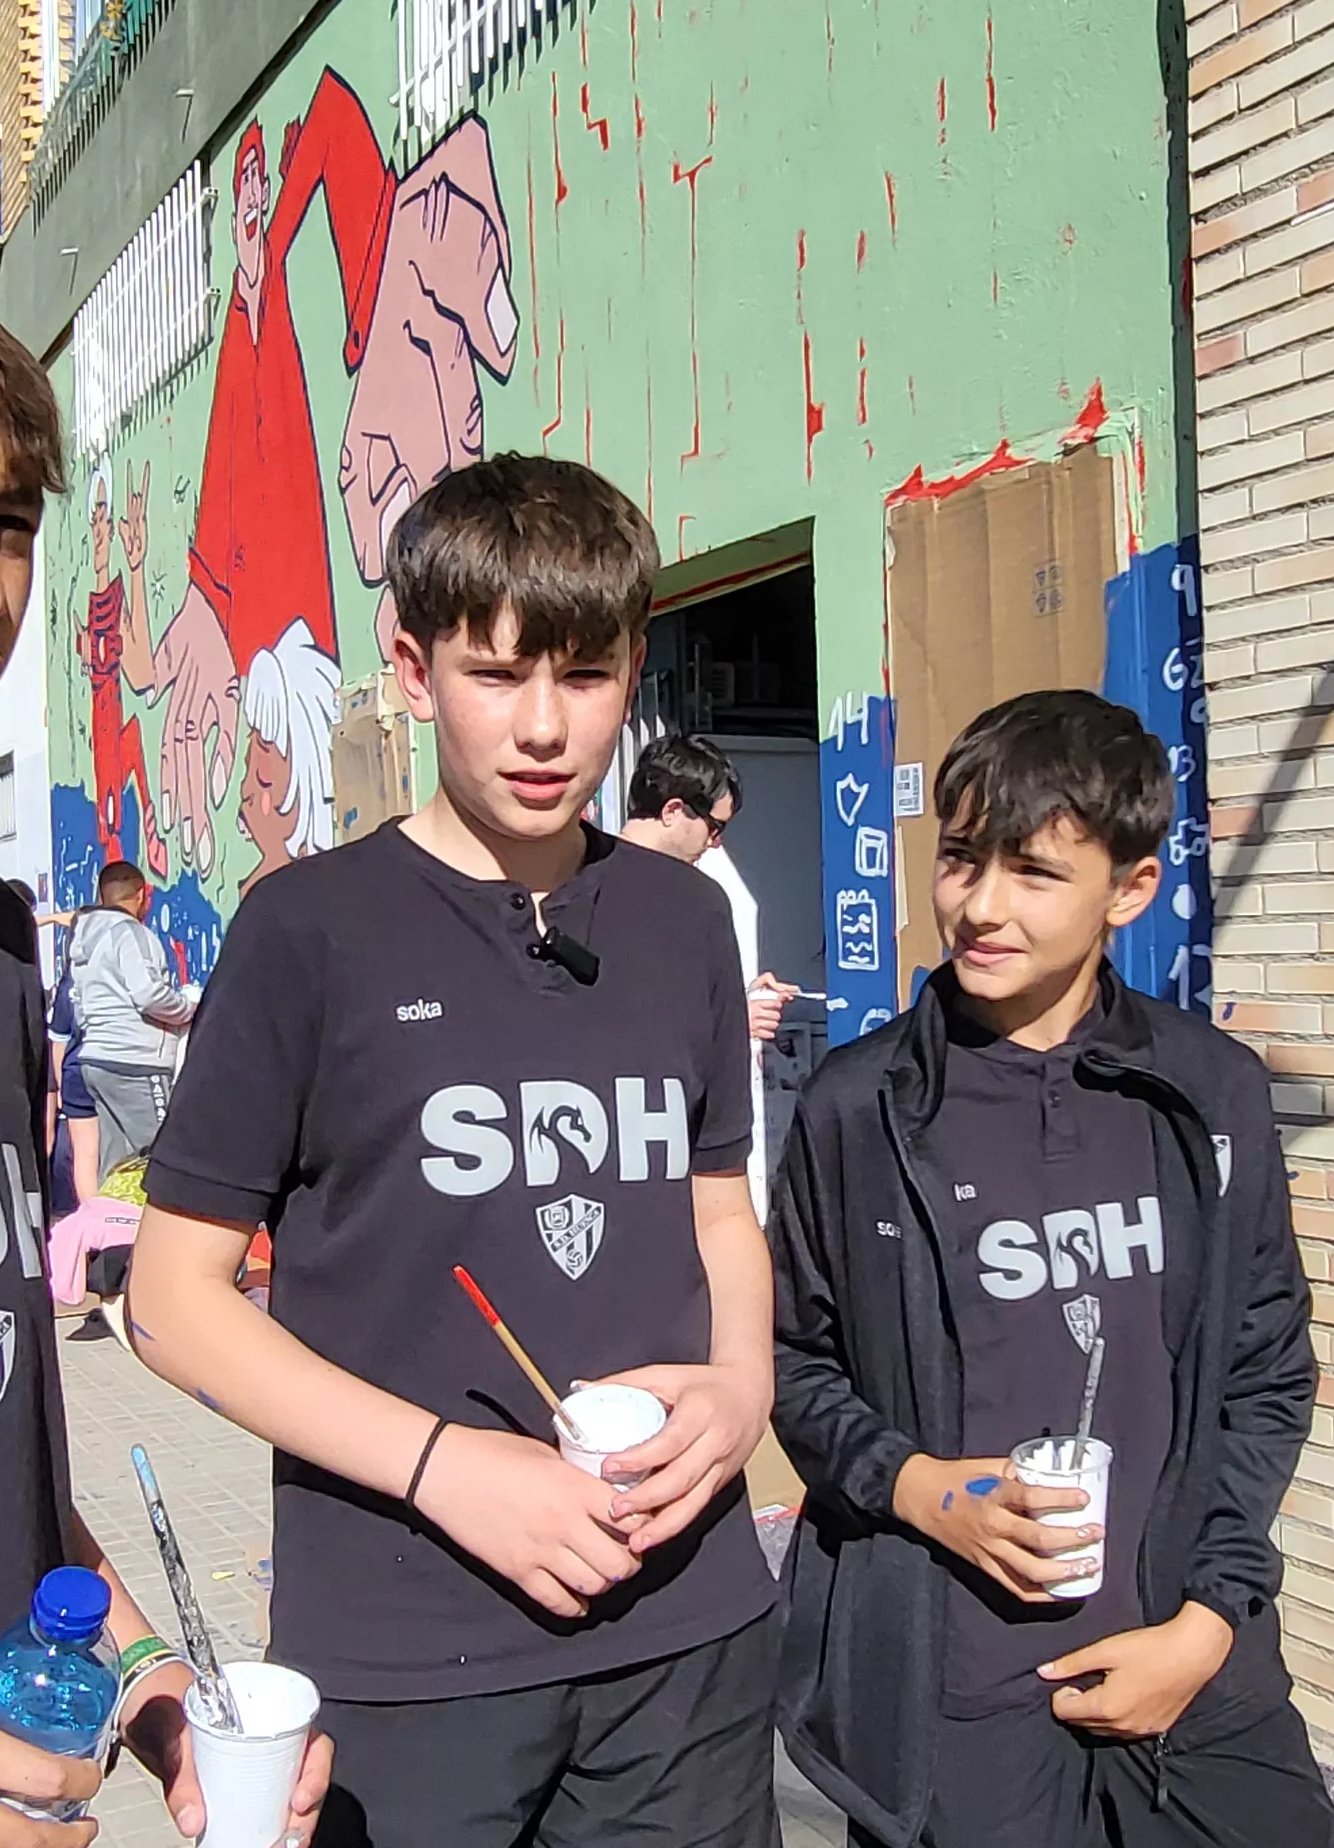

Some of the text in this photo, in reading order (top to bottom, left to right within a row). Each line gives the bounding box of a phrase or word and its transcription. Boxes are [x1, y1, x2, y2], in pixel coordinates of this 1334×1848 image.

[828, 691, 868, 751] 14
[396, 998, 443, 1022] soka
[419, 1076, 689, 1197] SDH
[953, 1183, 977, 1202] ka
[977, 1195, 1165, 1300] SDH
